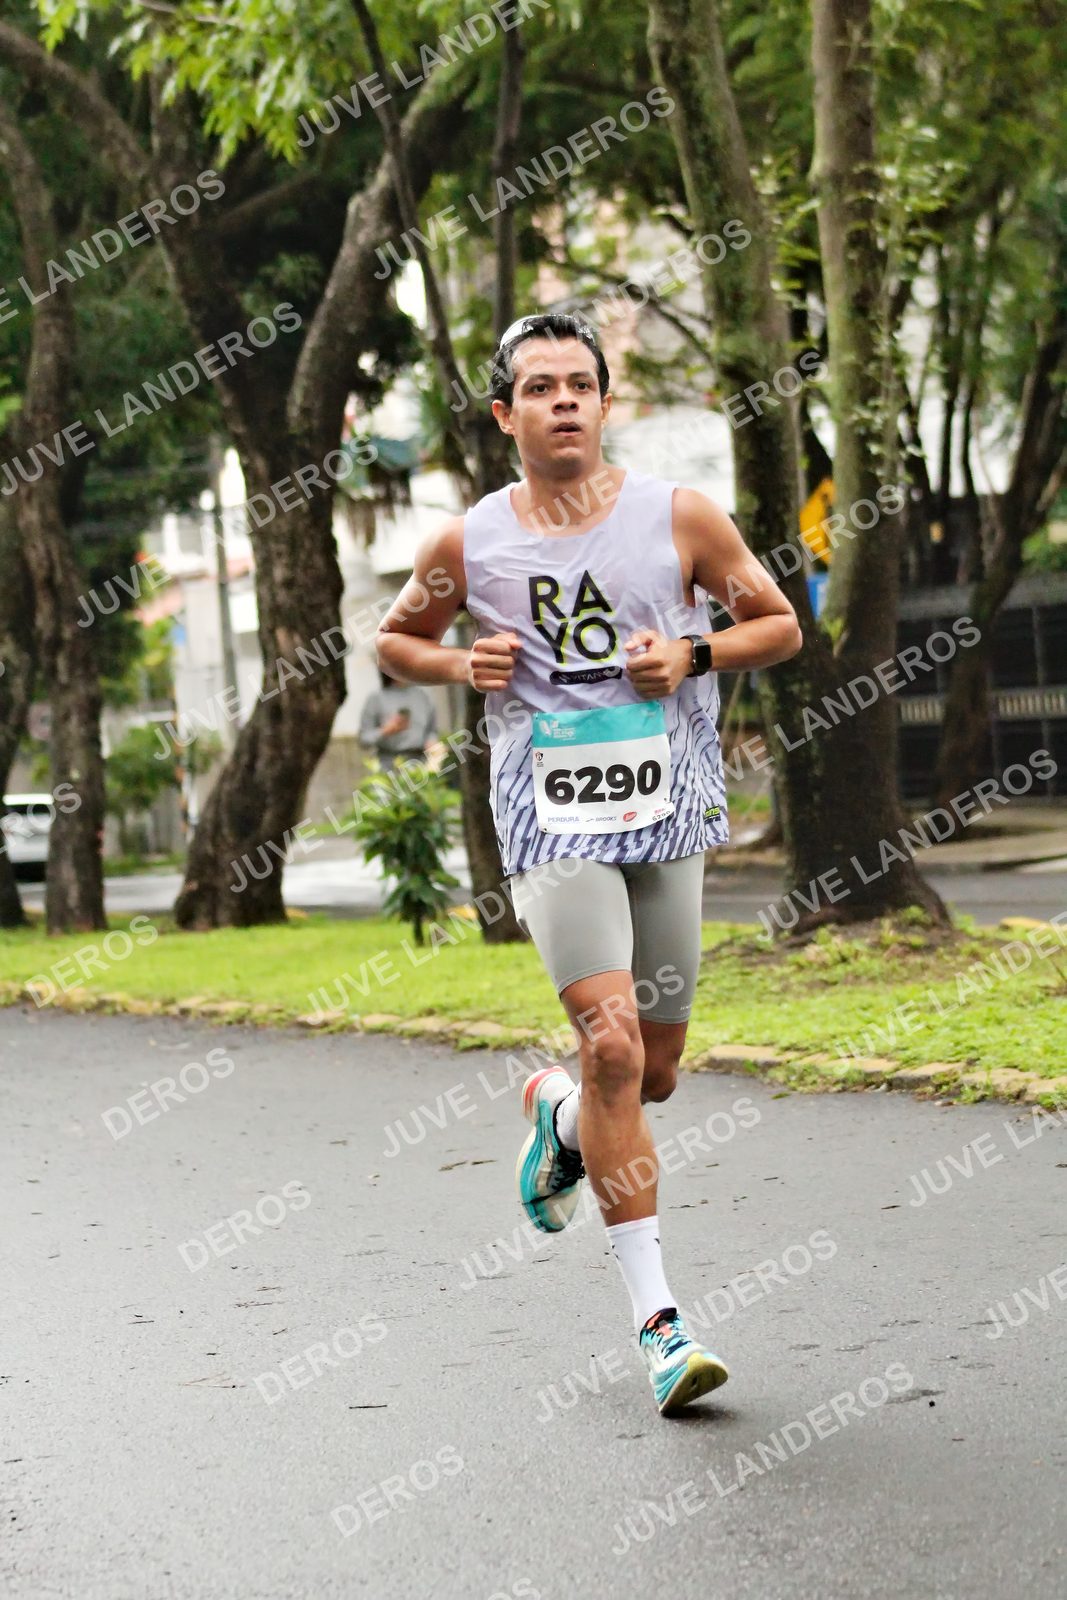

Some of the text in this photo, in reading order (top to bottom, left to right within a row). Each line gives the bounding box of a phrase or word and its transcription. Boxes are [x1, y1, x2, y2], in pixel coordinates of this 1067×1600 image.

[529, 570, 613, 621] RA
[534, 617, 617, 664] YO
[544, 760, 661, 805] 6290
